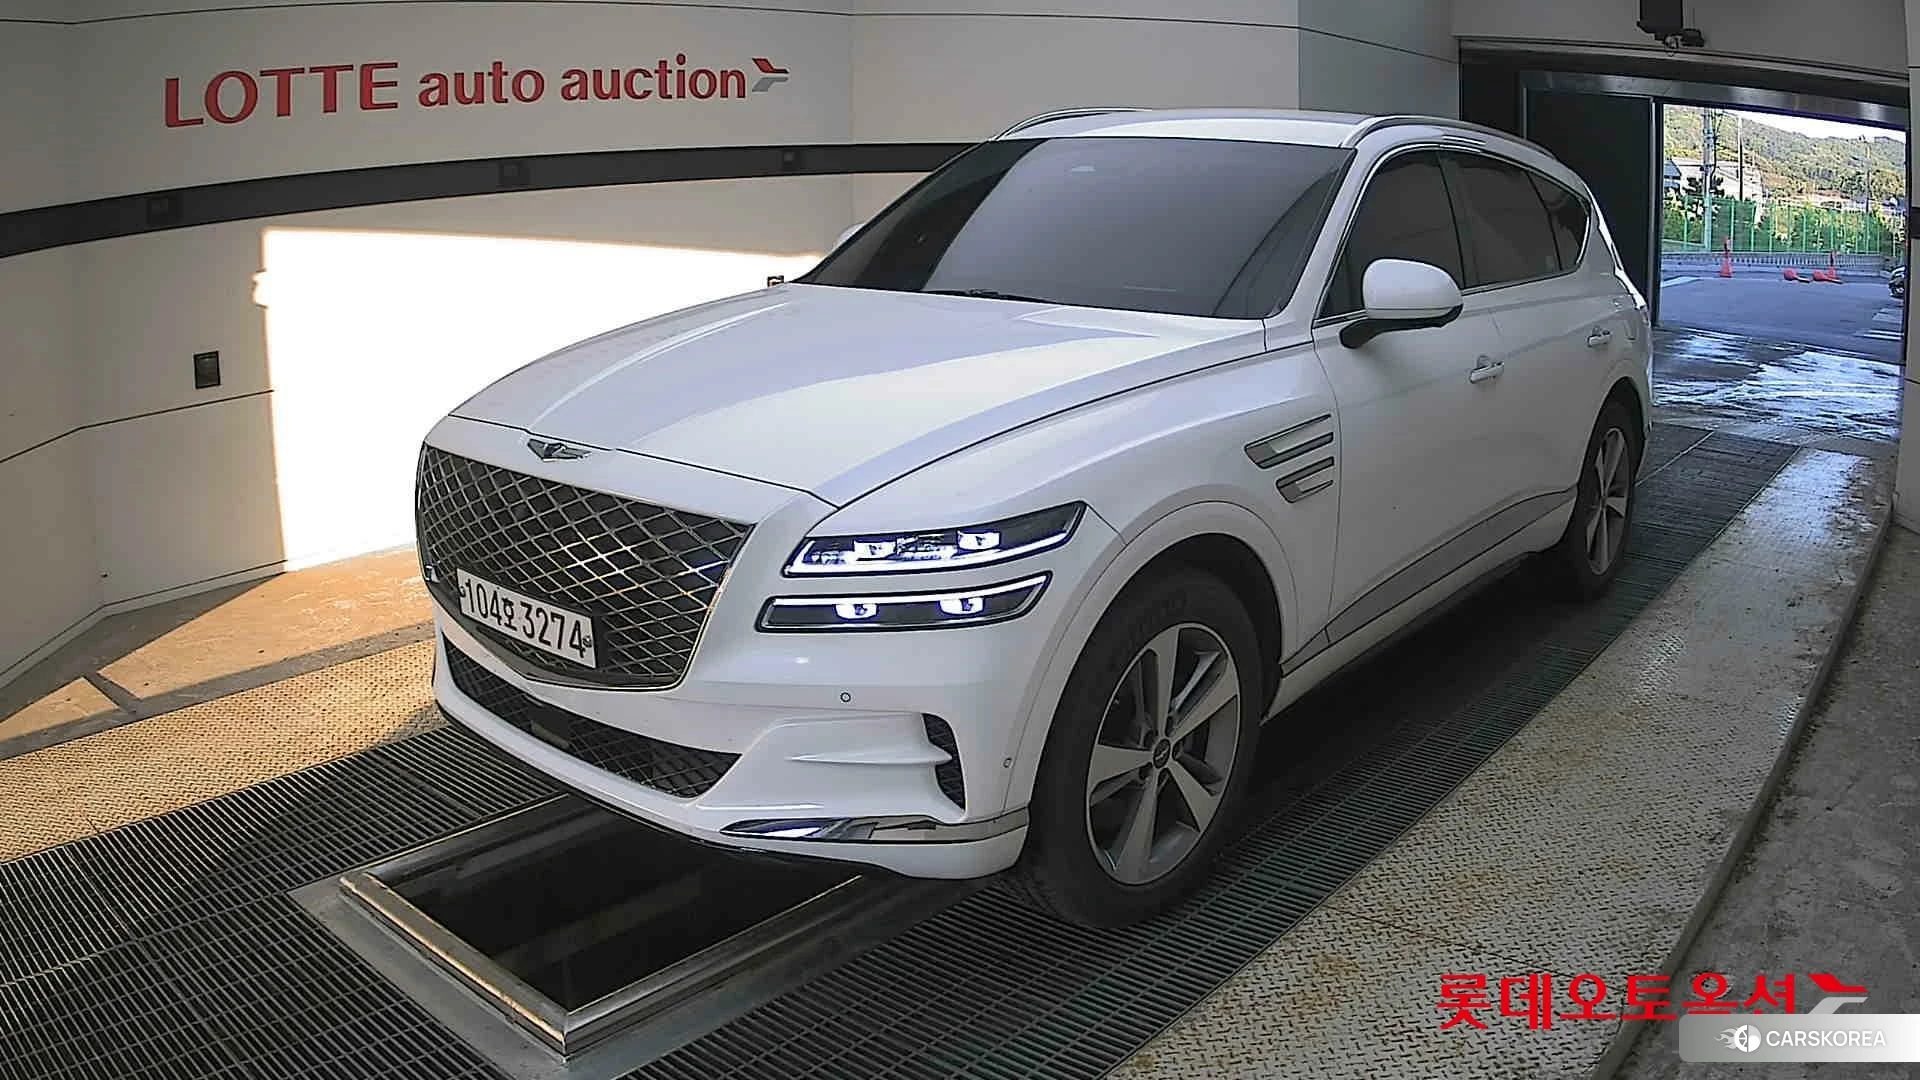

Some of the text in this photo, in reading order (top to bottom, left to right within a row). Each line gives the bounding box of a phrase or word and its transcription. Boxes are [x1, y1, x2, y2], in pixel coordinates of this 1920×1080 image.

[165, 53, 746, 128] LOTTE auto auction
[520, 601, 586, 658] 3274
